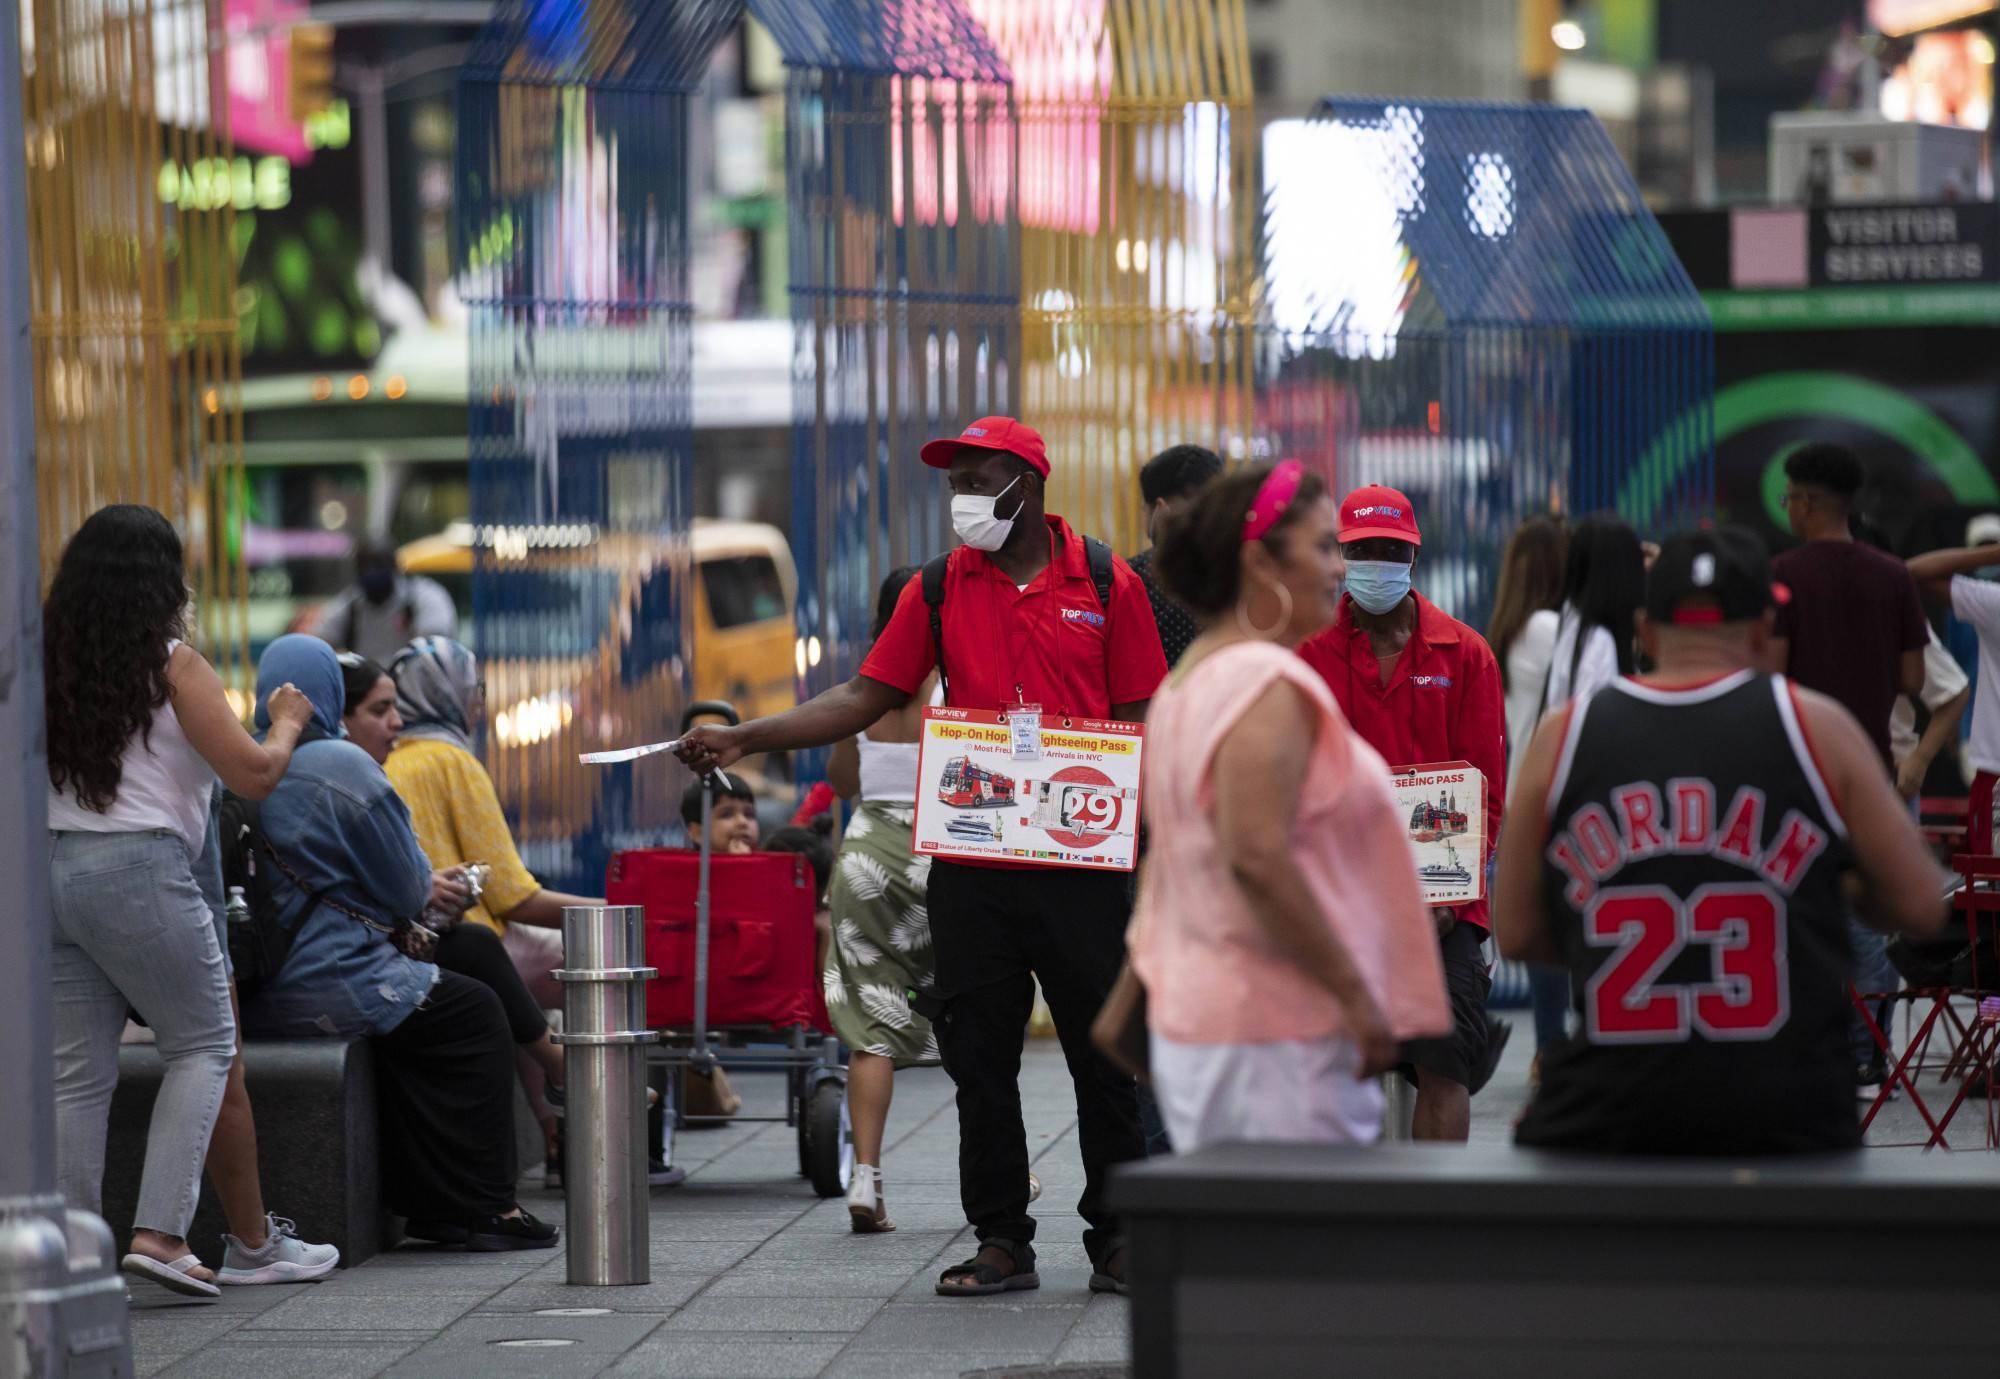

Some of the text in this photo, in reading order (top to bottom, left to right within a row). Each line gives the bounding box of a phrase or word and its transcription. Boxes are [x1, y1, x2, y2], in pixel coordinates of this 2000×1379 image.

[1825, 207, 1958, 243] VISITOR
[1825, 245, 1983, 281] SERVICES
[1353, 506, 1402, 519] TOPVIEW
[931, 708, 968, 718] TOPVIEW
[1083, 720, 1102, 729] Google
[940, 726, 983, 740] Hop-On
[985, 729, 1012, 744] Hop-
[1041, 733, 1098, 751] ightseeing
[1100, 740, 1127, 752] Pass
[974, 744, 993, 753] Most
[1046, 750, 1076, 760] Arrivals
[1086, 754, 1103, 762] NYC
[1394, 774, 1465, 788] SEEING PASS
[964, 845, 982, 853] Liberty
[1547, 777, 1828, 908] JORDAN
[1584, 882, 1790, 1045] 23
